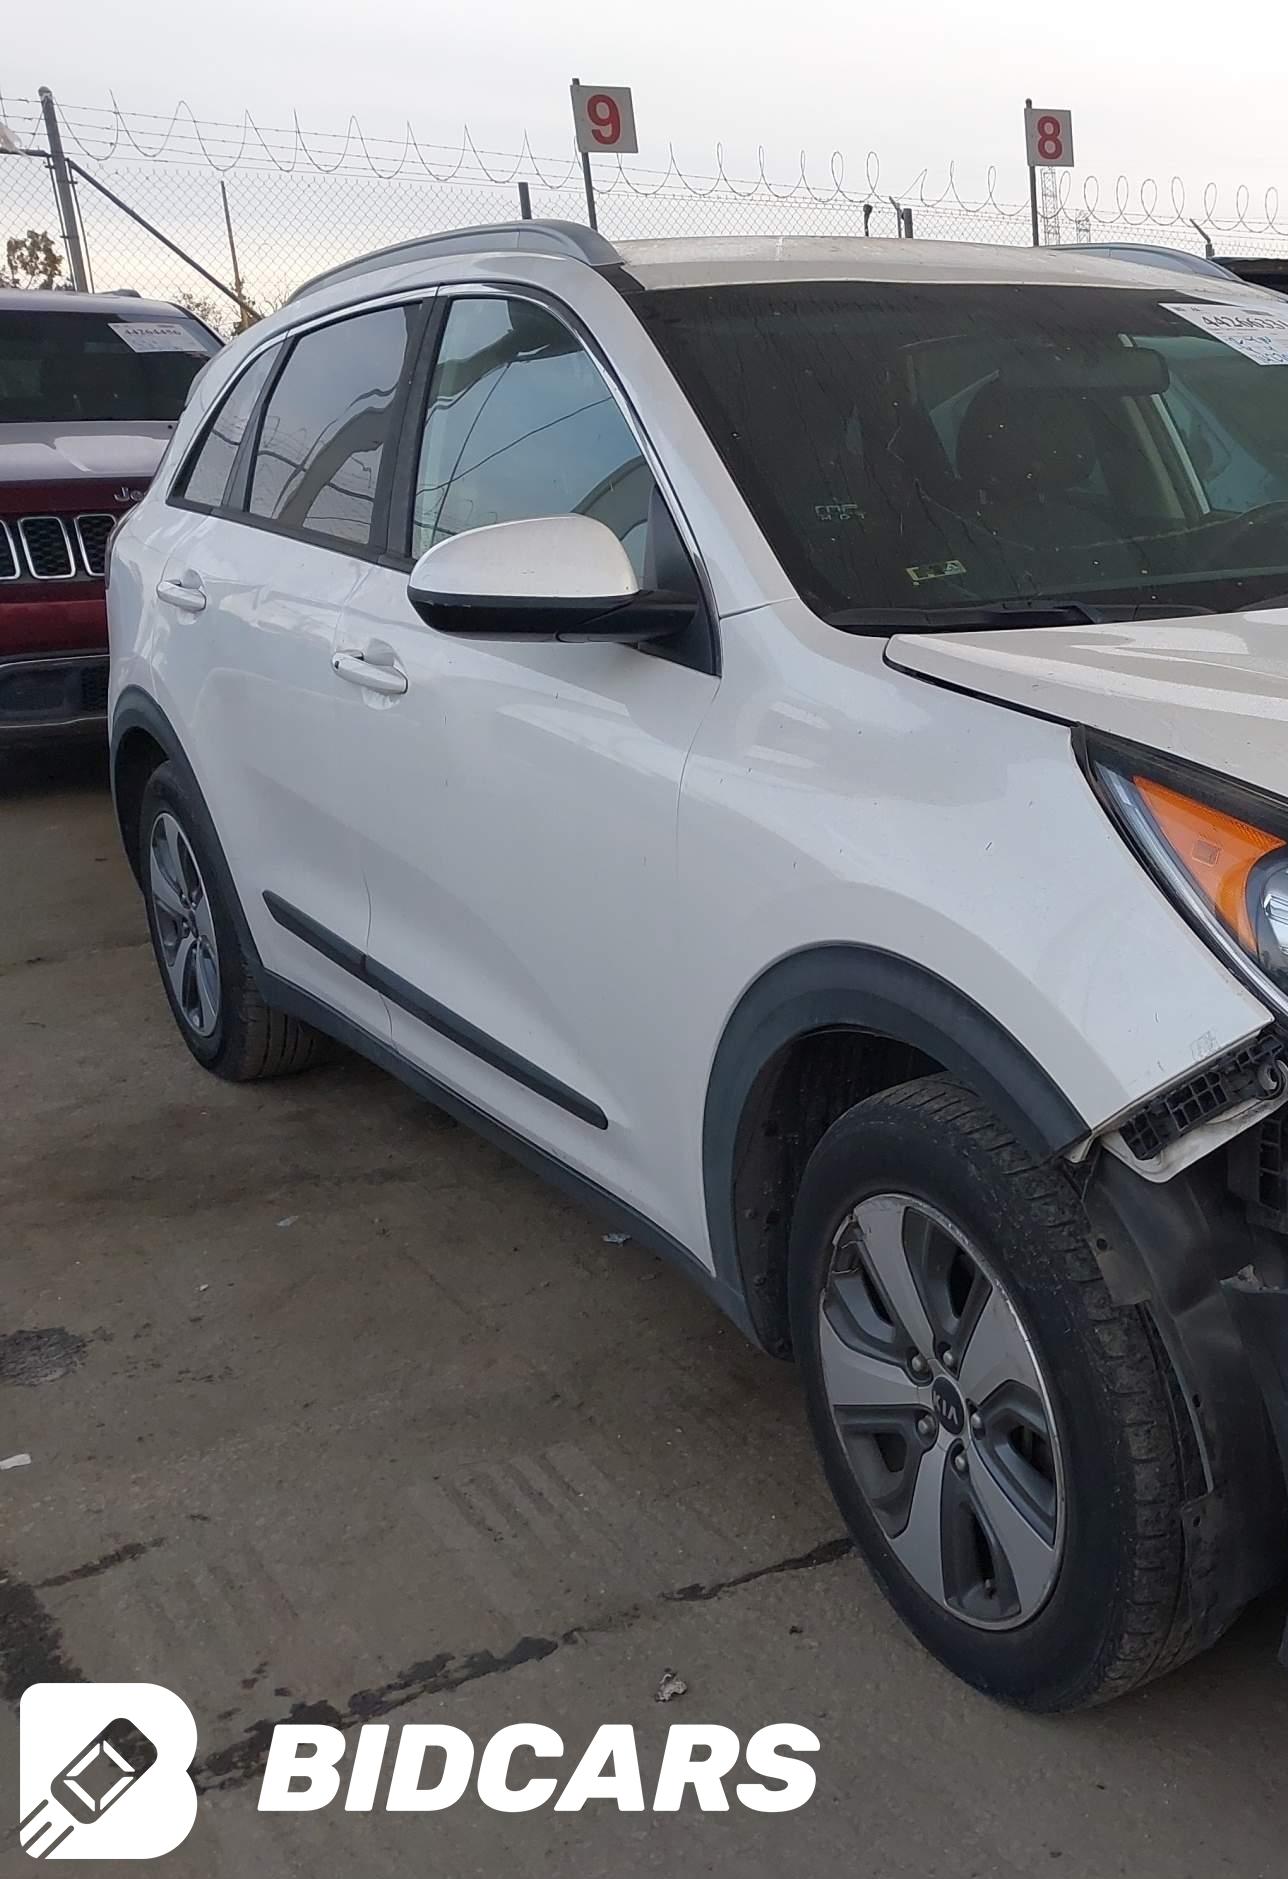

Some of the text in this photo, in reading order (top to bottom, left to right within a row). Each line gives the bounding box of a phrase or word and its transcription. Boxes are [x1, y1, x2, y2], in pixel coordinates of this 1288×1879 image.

[587, 94, 621, 145] 9
[1037, 115, 1063, 160] 8
[932, 1390, 959, 1425] KIA
